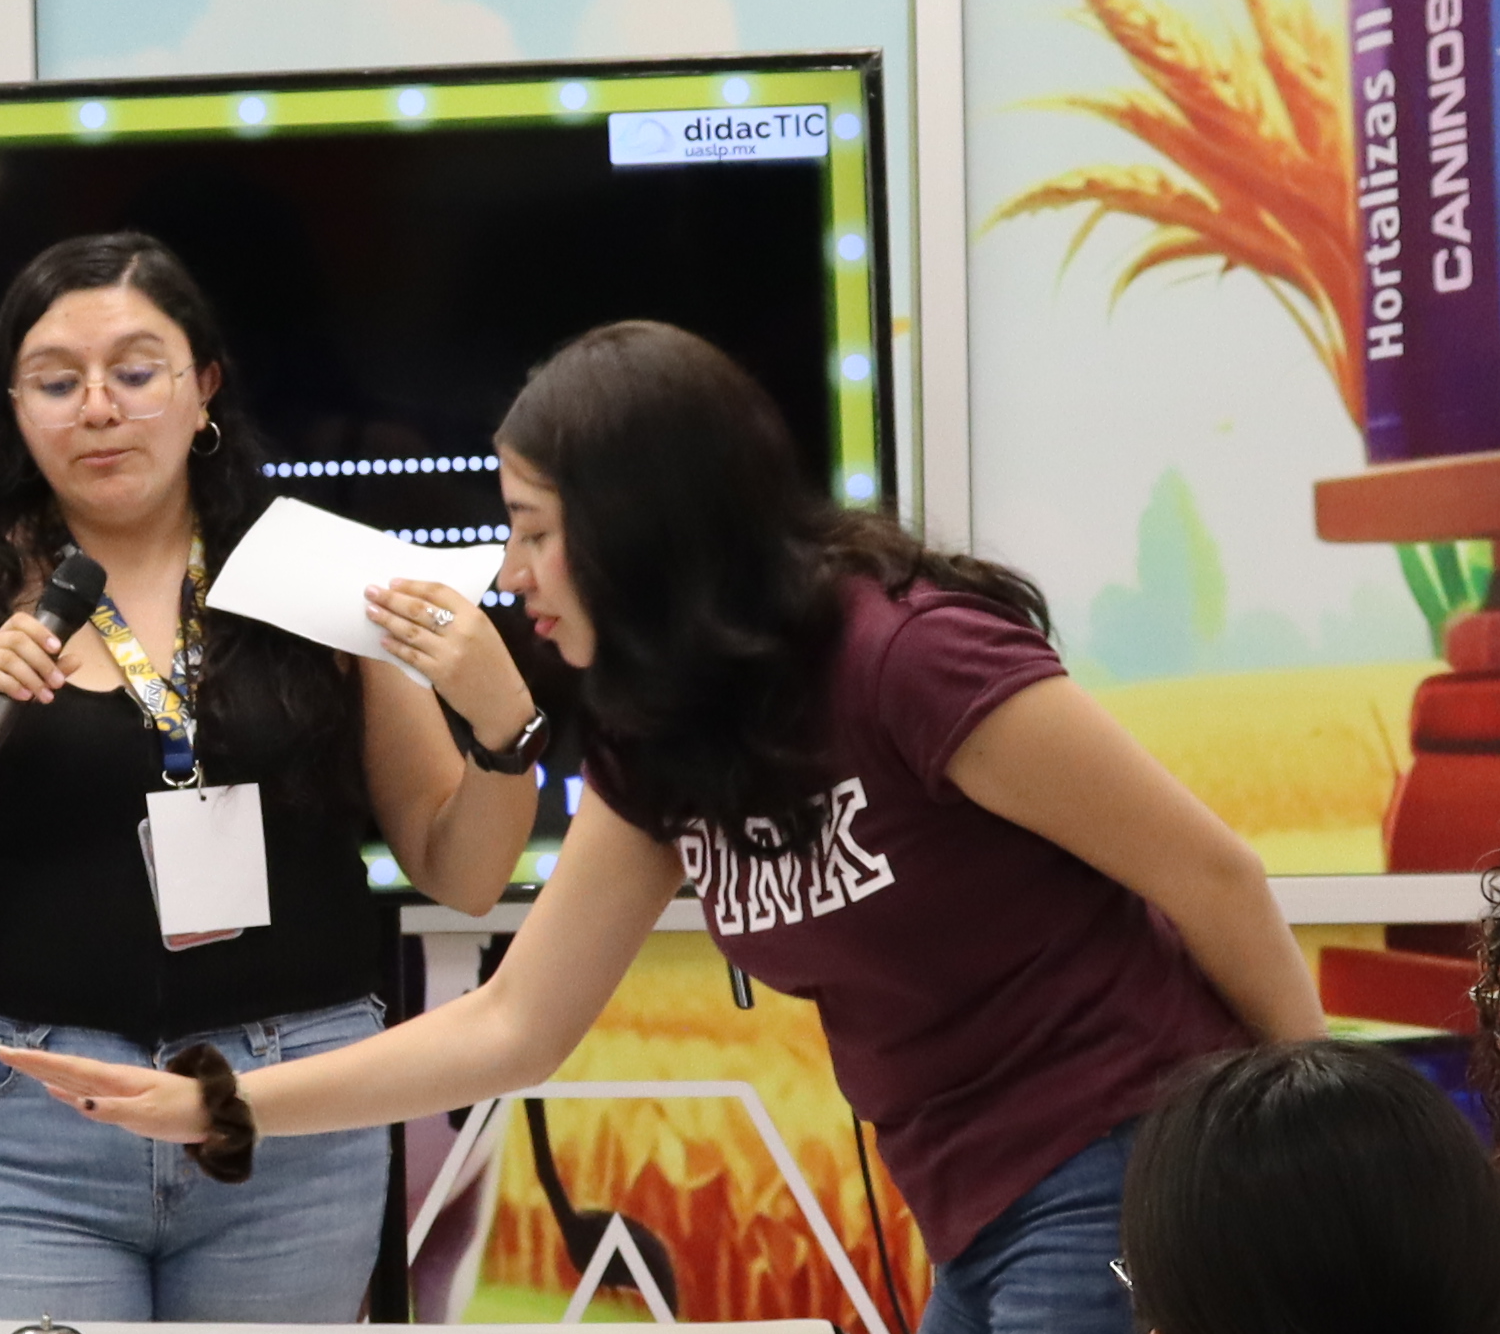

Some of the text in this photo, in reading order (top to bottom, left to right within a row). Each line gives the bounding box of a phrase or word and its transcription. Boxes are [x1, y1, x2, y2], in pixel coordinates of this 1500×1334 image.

[683, 112, 826, 142] didacTIC
[685, 142, 757, 161] uaslp.mx
[1354, 6, 1405, 361] Hortalizas II
[677, 776, 896, 936] PINK
